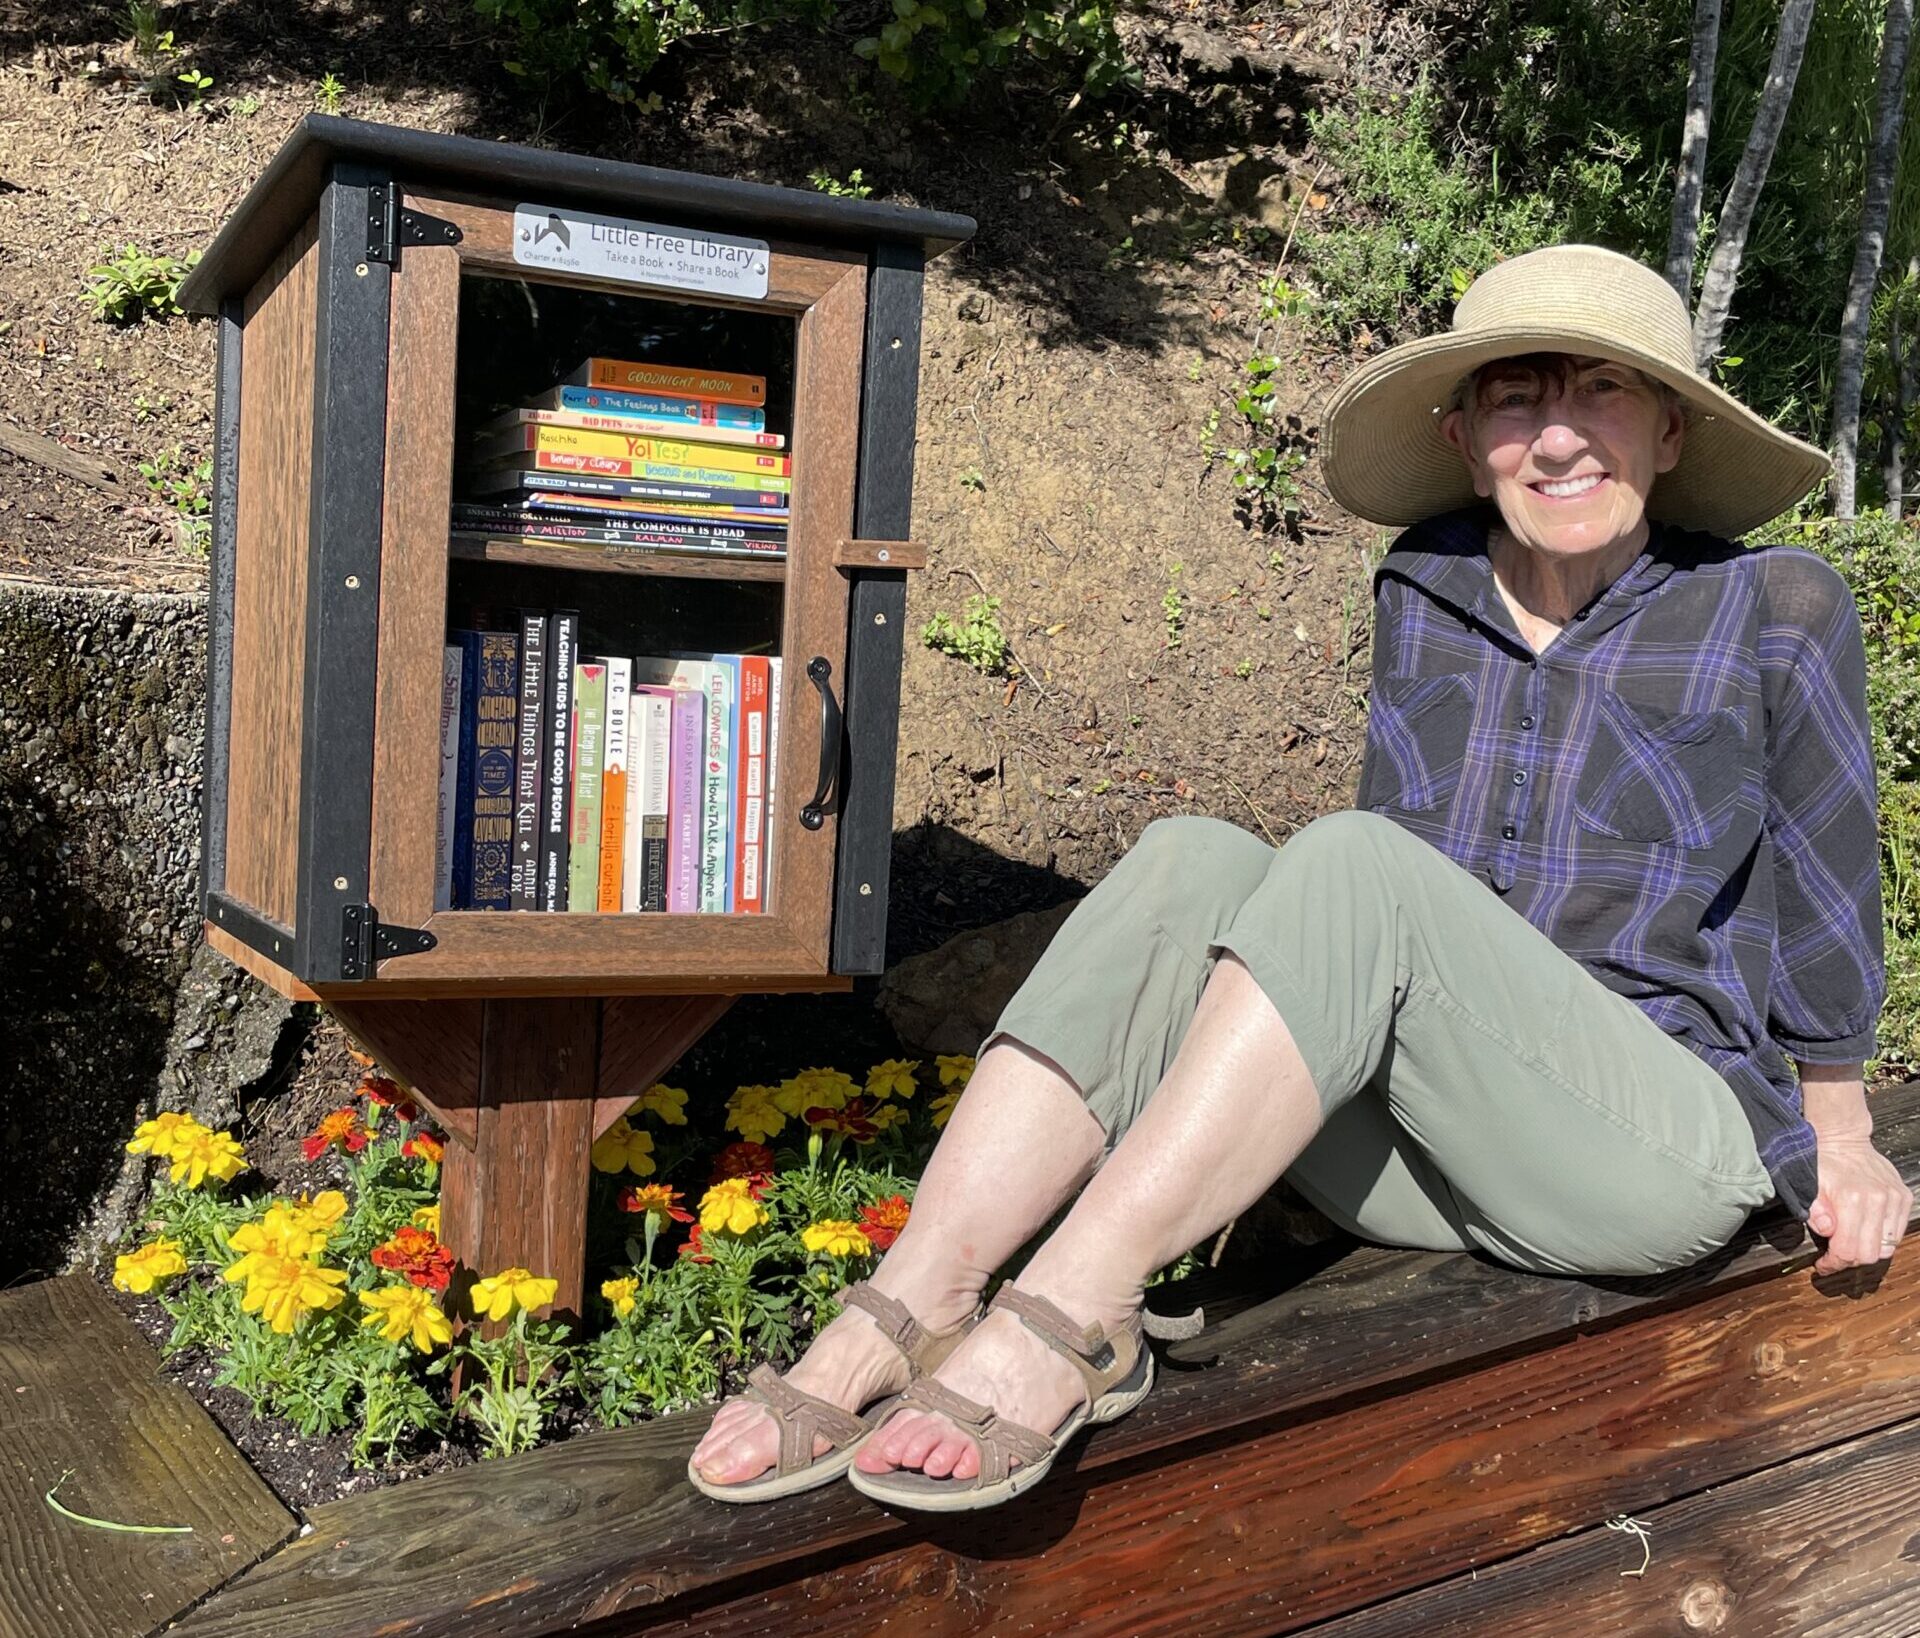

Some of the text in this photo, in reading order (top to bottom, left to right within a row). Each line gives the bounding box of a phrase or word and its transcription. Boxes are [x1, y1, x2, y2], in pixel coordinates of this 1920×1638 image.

[524, 251, 550, 262] Charter
[591, 223, 755, 269] Little Free Library
[605, 250, 740, 279] Take a Book Share a Book
[627, 371, 695, 388] GOODNIGHT
[699, 379, 734, 392] MOON
[603, 397, 680, 413] The Feelings Book
[582, 416, 599, 427] BAD
[601, 418, 622, 429] PETS
[550, 453, 622, 473] Beverly Cleary
[625, 435, 690, 464] Yo! Yes?
[524, 524, 535, 534] A
[605, 519, 629, 529] THE
[632, 520, 695, 534] COMPOSER
[699, 526, 710, 535] IS
[713, 528, 746, 538] DEAD
[635, 533, 683, 544] KALMAN
[526, 616, 544, 646] THE
[551, 618, 570, 833] TEACHING KIDS TO BE GOOD PEOPLE
[610, 671, 625, 754] T.C. BOYLE
[709, 674, 722, 758] LEIL LOWNDES
[578, 724, 601, 766] Deception
[751, 715, 760, 753] Calmer
[652, 741, 664, 767] ALICE
[685, 743, 694, 757] OF
[482, 771, 507, 779] TIMES
[684, 759, 693, 778] MY
[750, 760, 758, 792] Easier
[579, 772, 598, 798] Artist
[651, 769, 663, 812] HOFFMAN
[684, 779, 693, 808] SOUL
[708, 777, 720, 805] How
[707, 811, 719, 845] TALK
[747, 801, 759, 840] Happier
[604, 817, 619, 860] tortilla
[649, 838, 659, 866] HERE
[548, 851, 558, 877] ANNIE
[680, 813, 692, 906] ISABEL ALLENDE
[745, 848, 757, 897] Parenting
[511, 865, 523, 892] FOX
[602, 864, 616, 906] curtain
[648, 869, 659, 882] ON
[703, 853, 718, 897] Anyone
